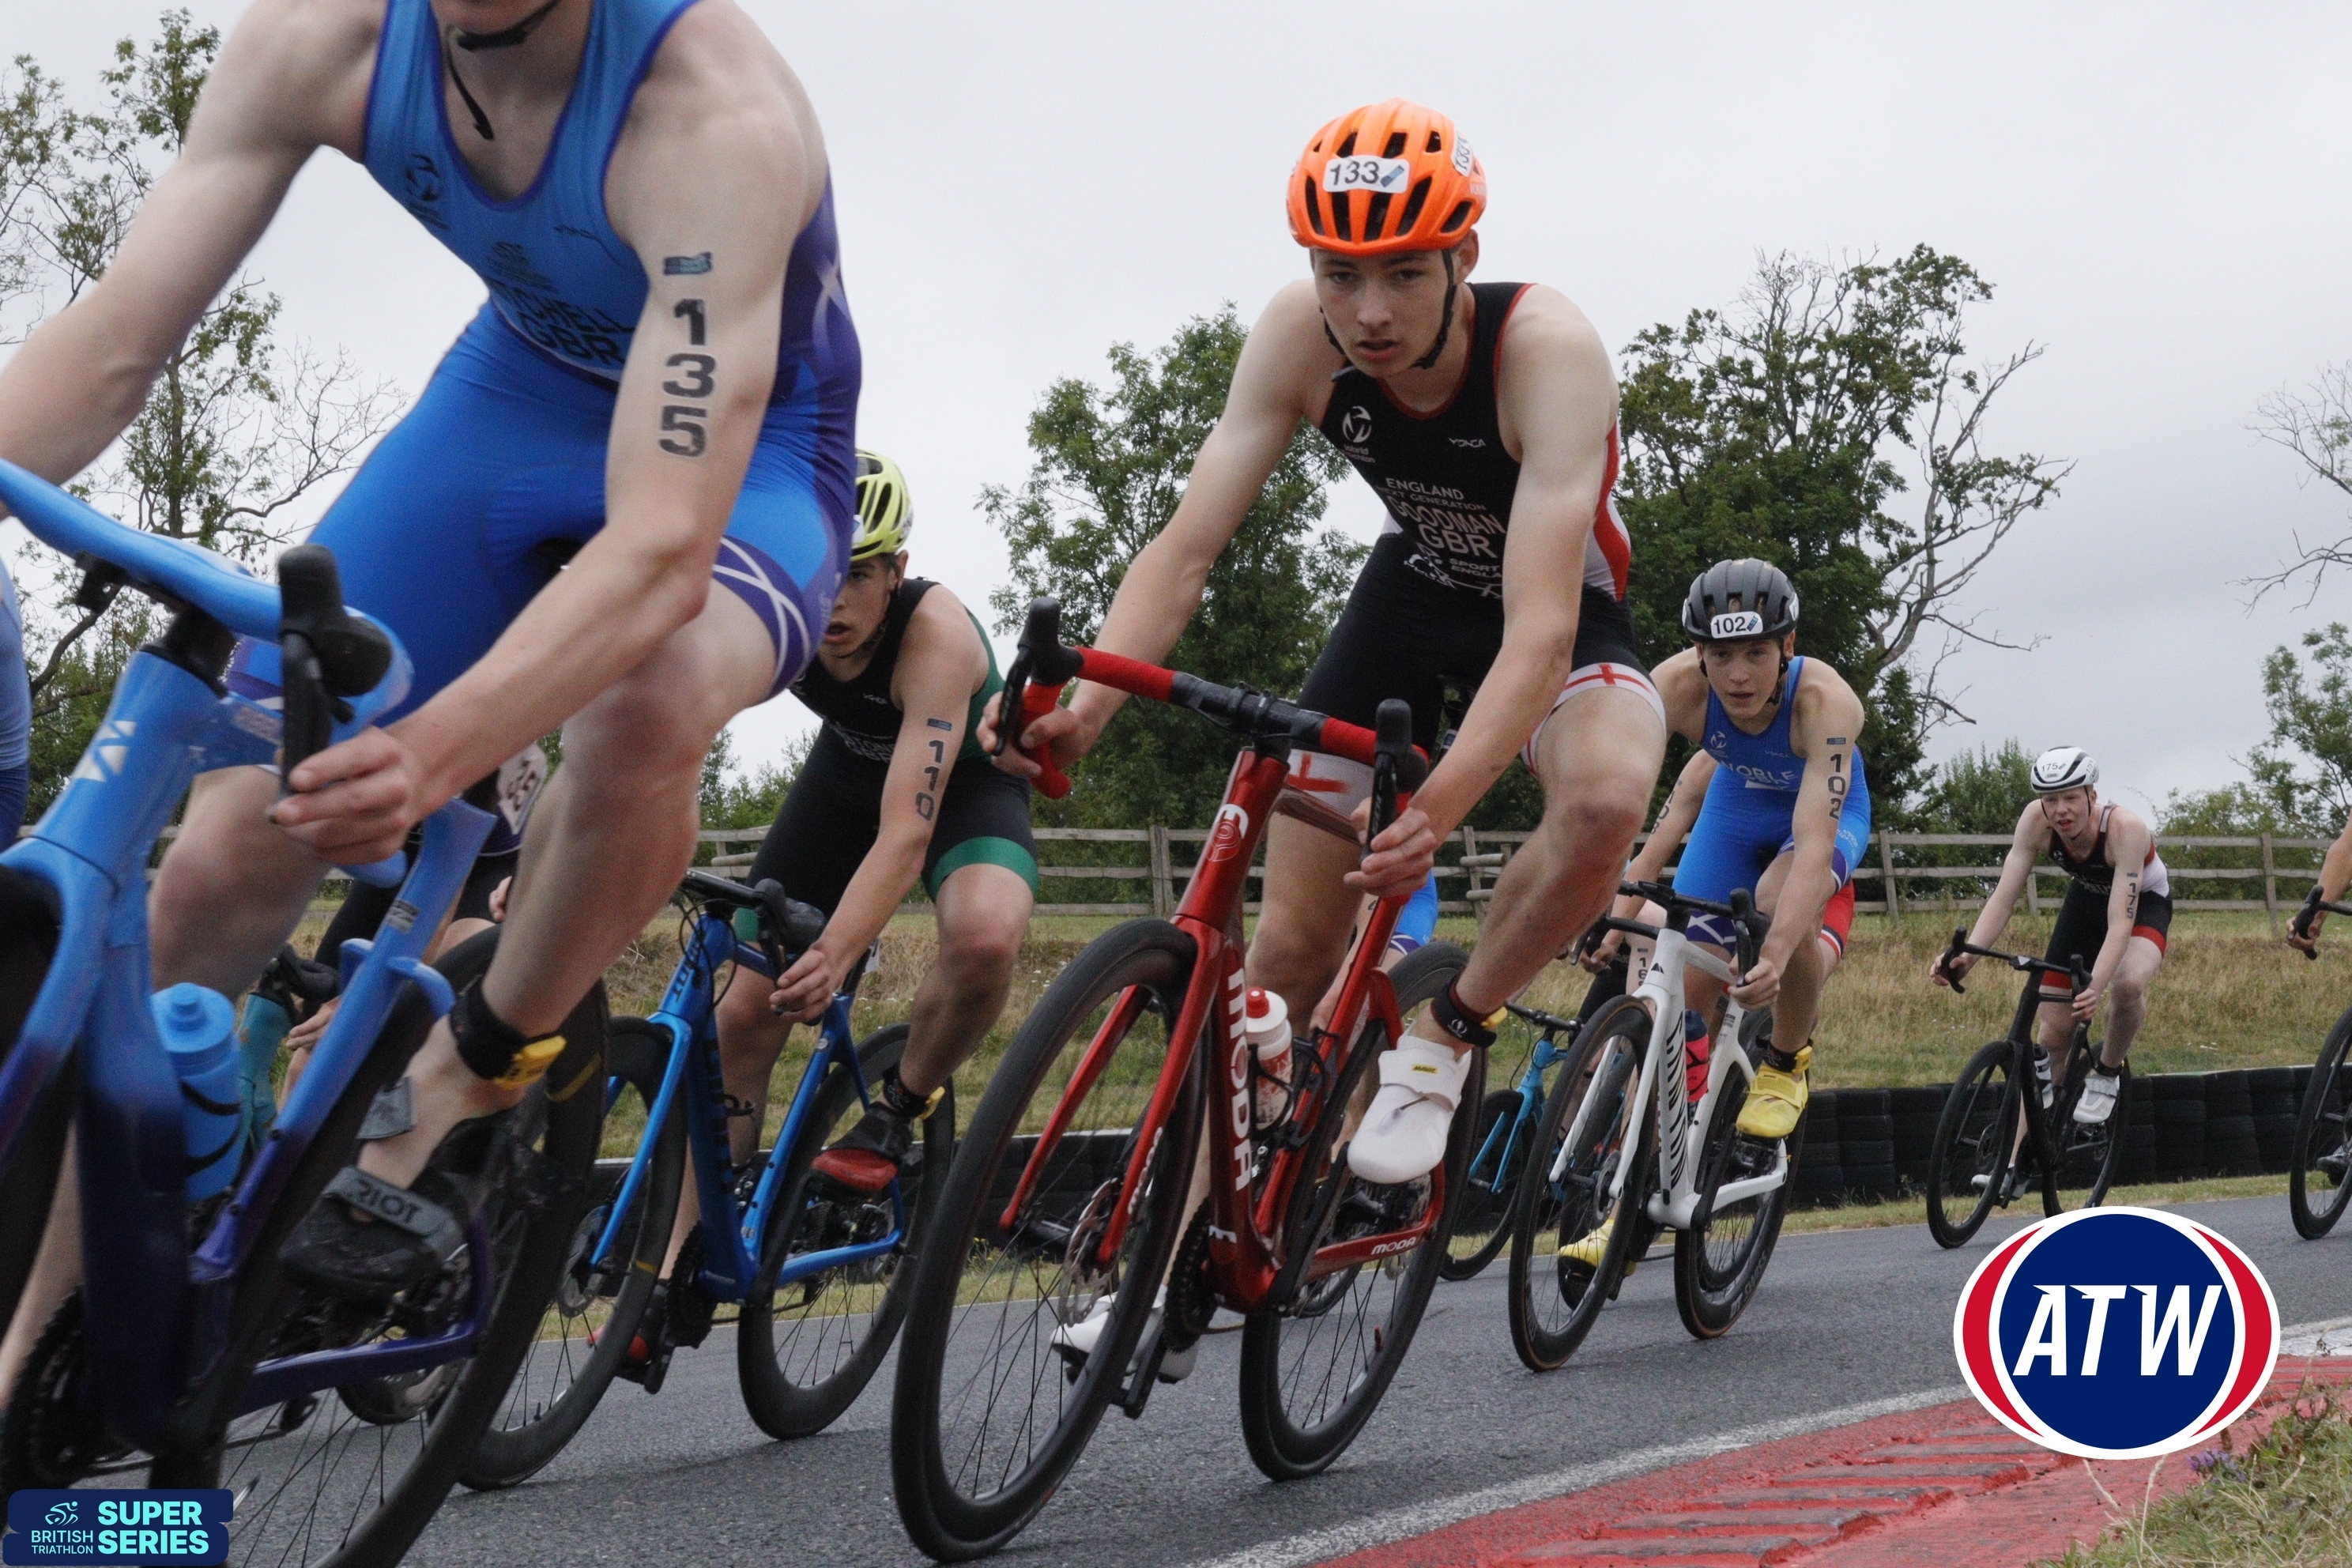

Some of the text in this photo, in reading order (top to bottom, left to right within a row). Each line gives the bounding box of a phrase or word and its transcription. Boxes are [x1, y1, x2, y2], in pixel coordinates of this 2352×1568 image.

[1330, 160, 1379, 186] 133
[658, 299, 717, 458] 135
[1385, 477, 1464, 500] ENGLAND
[1386, 496, 1507, 534] GOODMAN
[1410, 493, 1486, 511] GENERATION
[1419, 524, 1498, 559] GBR
[1449, 558, 1500, 572] SPORT
[1451, 565, 1502, 579] ENGLA
[1713, 616, 1747, 635] 102
[916, 740, 944, 821] 110
[2041, 763, 2059, 772] 175
[1827, 753, 1846, 820] 102
[2127, 882, 2136, 919] 175
